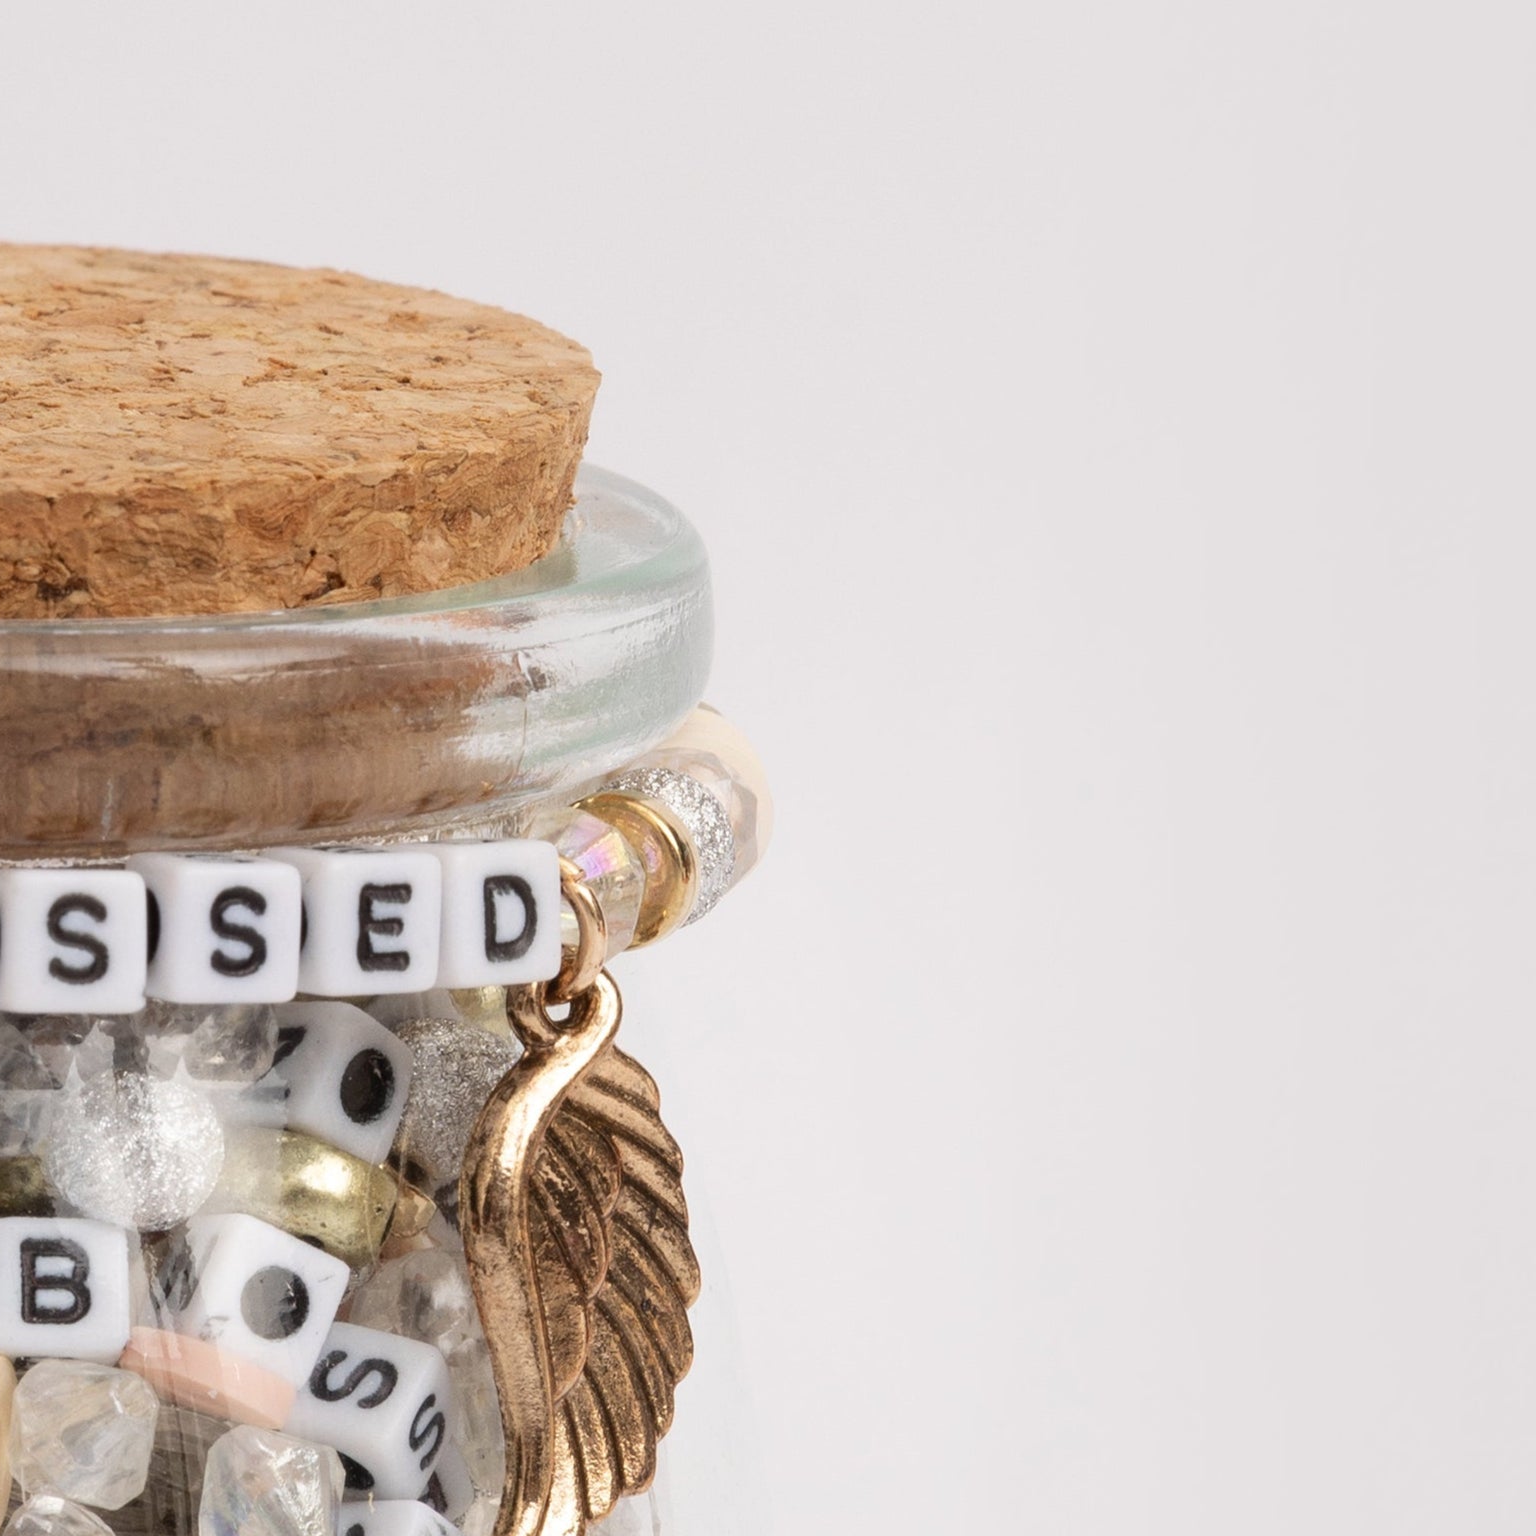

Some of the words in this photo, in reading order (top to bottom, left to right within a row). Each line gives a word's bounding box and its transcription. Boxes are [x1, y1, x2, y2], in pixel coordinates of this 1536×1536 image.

[19, 1237, 92, 1325] B
[308, 1349, 399, 1410] S
[408, 1393, 446, 1471] S
